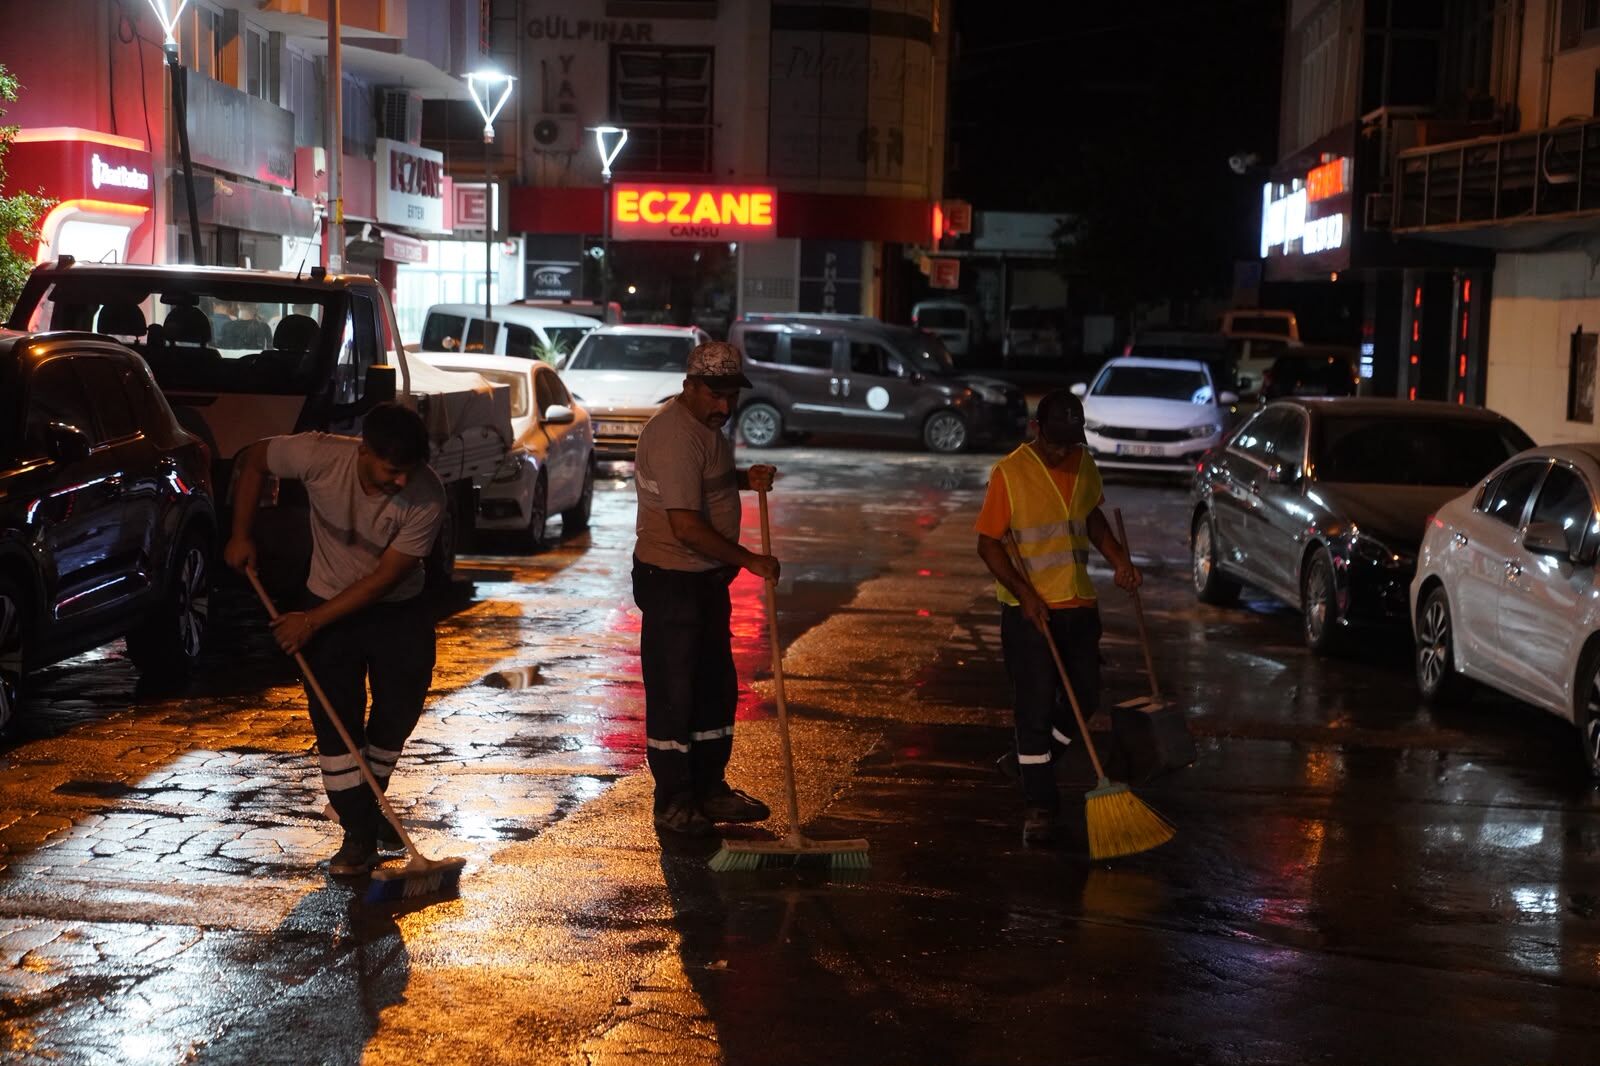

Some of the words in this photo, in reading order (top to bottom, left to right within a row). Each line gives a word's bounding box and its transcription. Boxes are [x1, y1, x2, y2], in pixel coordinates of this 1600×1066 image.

[527, 16, 654, 42] GÜLPINAR
[617, 190, 773, 226] ECZANE
[670, 225, 720, 238] CANSU
[823, 251, 837, 313] PHAR
